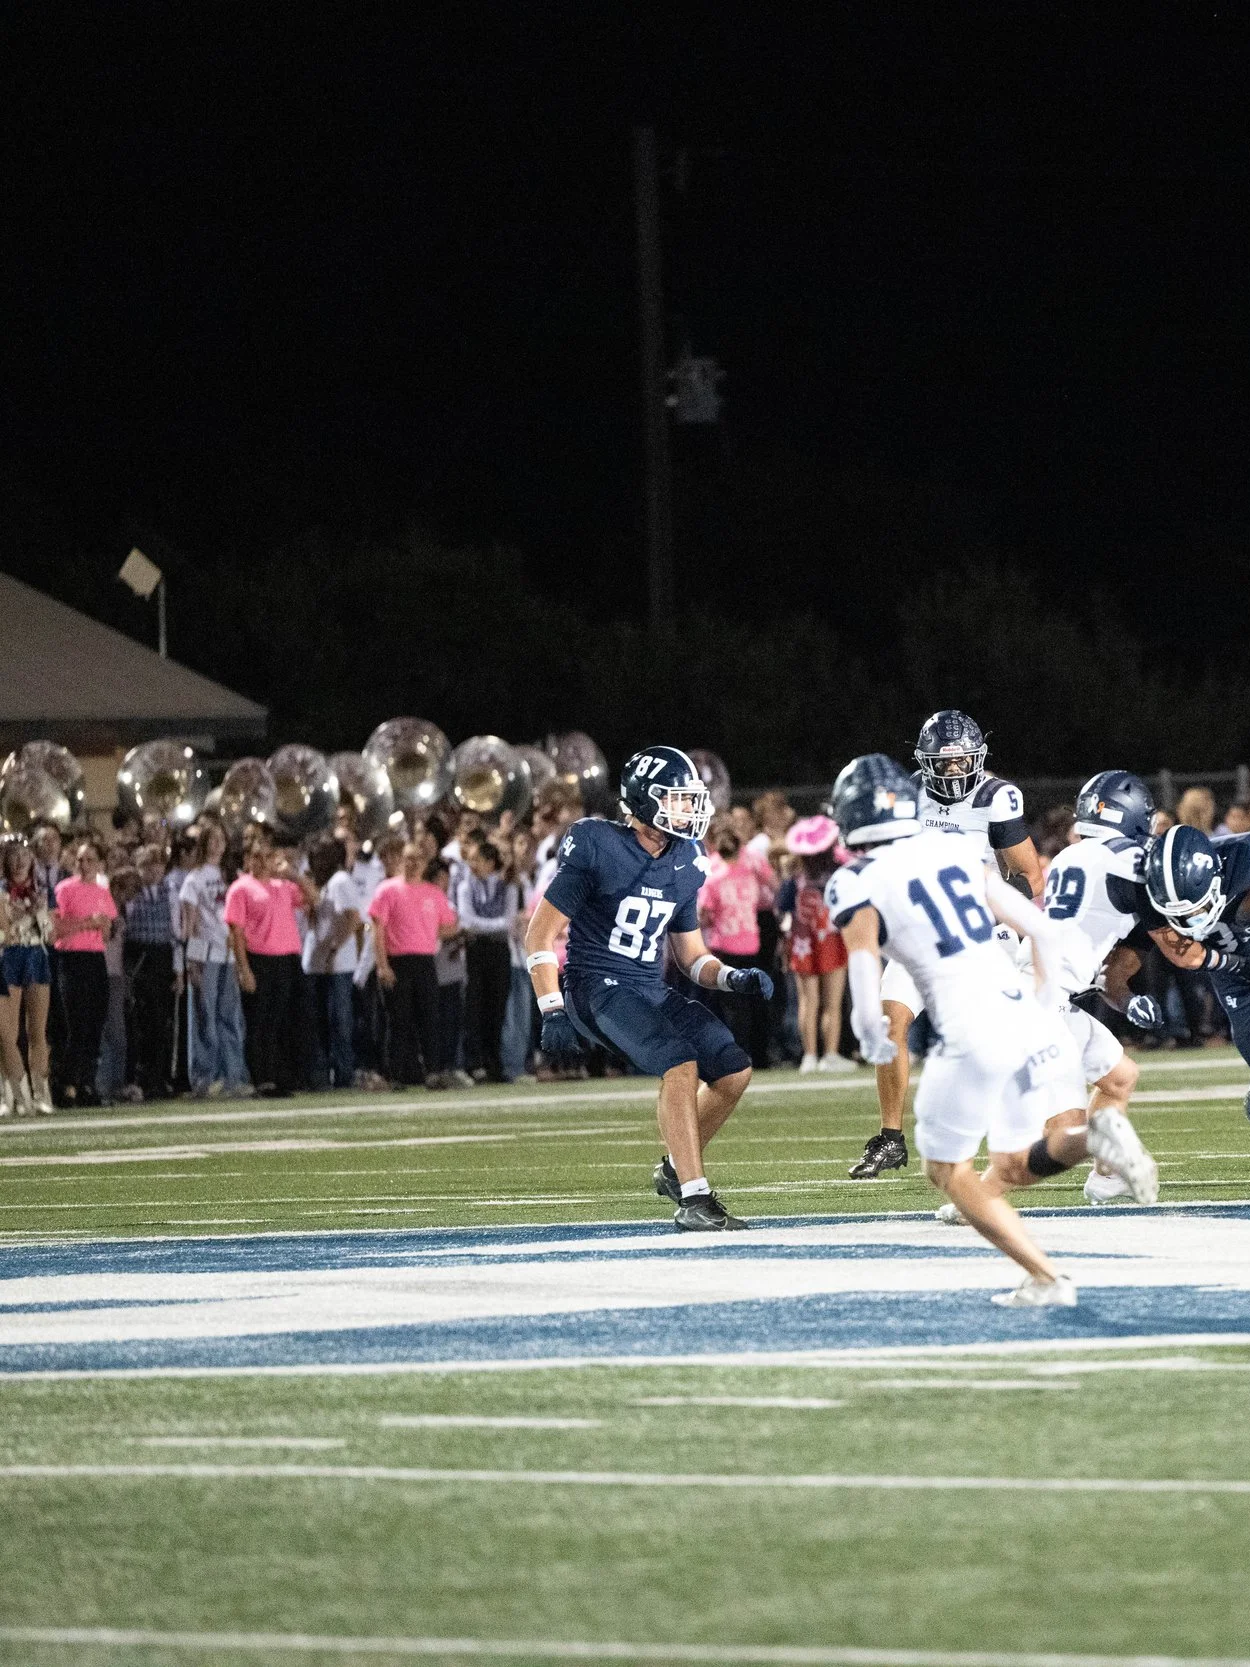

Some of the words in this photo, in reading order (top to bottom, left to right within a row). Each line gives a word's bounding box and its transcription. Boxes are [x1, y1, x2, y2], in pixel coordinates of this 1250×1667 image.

[635, 755, 668, 780] 87
[1007, 789, 1019, 813] 5
[608, 895, 677, 962] 87
[907, 864, 993, 959] 16
